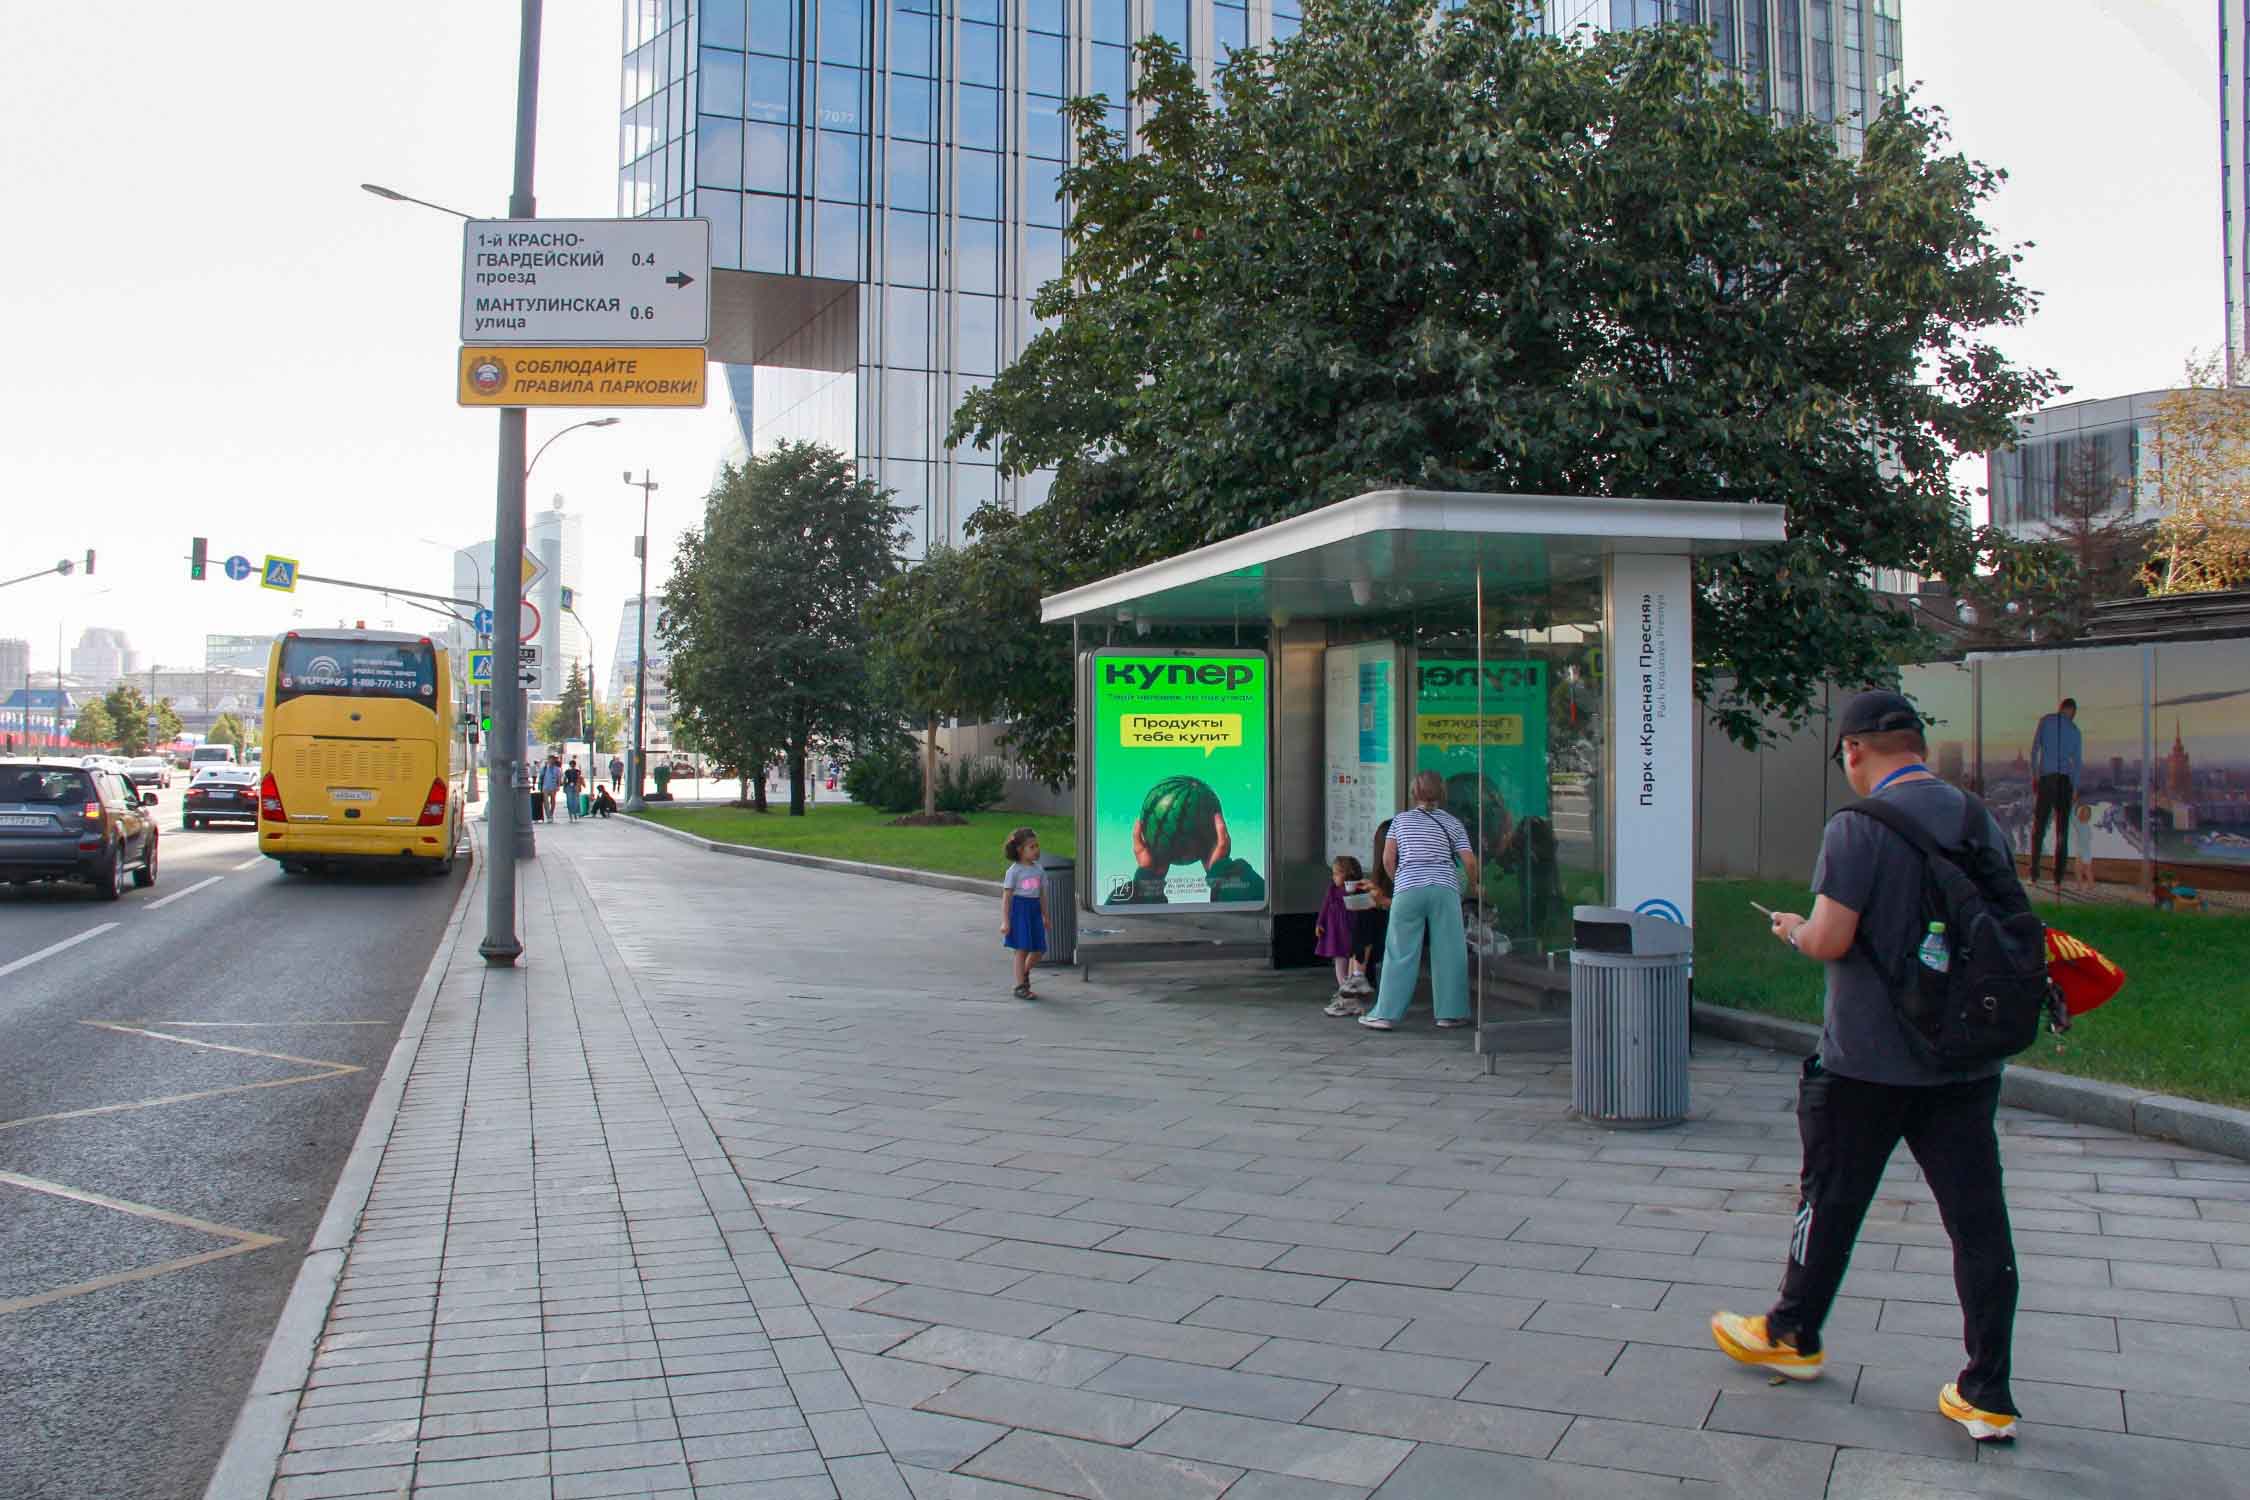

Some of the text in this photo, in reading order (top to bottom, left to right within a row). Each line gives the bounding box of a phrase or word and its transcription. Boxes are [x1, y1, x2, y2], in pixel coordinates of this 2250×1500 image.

[478, 233, 585, 247] 1-й КРАСНО-
[477, 251, 656, 268] ГВАРДЕЙСКИЙ 0.4
[476, 271, 537, 286] проезд
[475, 298, 621, 312] МАНТУЛИНСКАЯ
[629, 306, 655, 320] 0.6
[475, 316, 527, 331] улица
[514, 359, 638, 376] СОБЛЮДАЙТЕ
[513, 379, 699, 394] ПРАВИЛА ПАРКОВКИ!
[1106, 663, 1254, 691] купер
[1639, 594, 1655, 806] Парк «Красная Пресня»
[1133, 717, 1223, 730] Продукты
[1133, 731, 1230, 744] тебе купит
